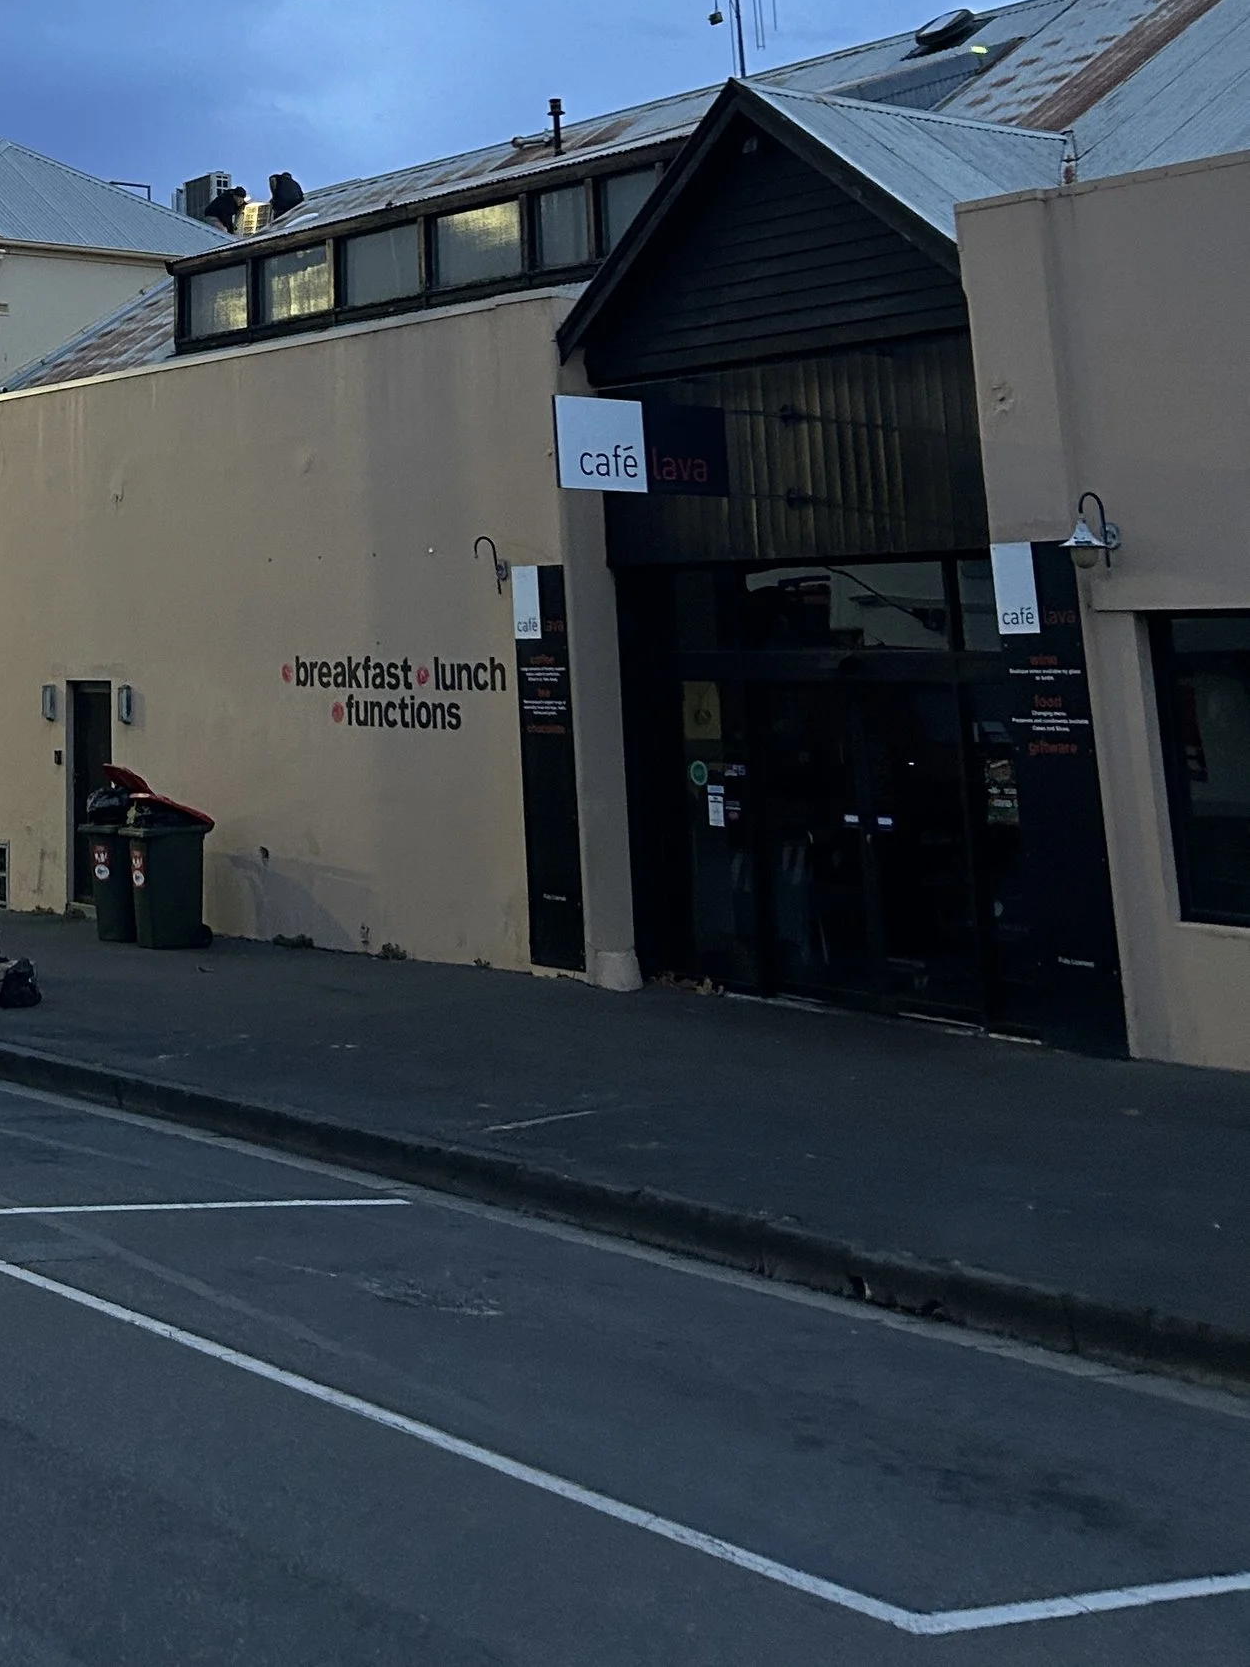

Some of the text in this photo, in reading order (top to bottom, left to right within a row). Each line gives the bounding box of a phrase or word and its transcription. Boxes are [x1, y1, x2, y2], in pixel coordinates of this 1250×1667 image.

[579, 445, 710, 483] café lava
[516, 617, 538, 633] café
[1002, 606, 1076, 625] café lava
[295, 656, 506, 691] breakfast lunch
[346, 694, 461, 730] functions
